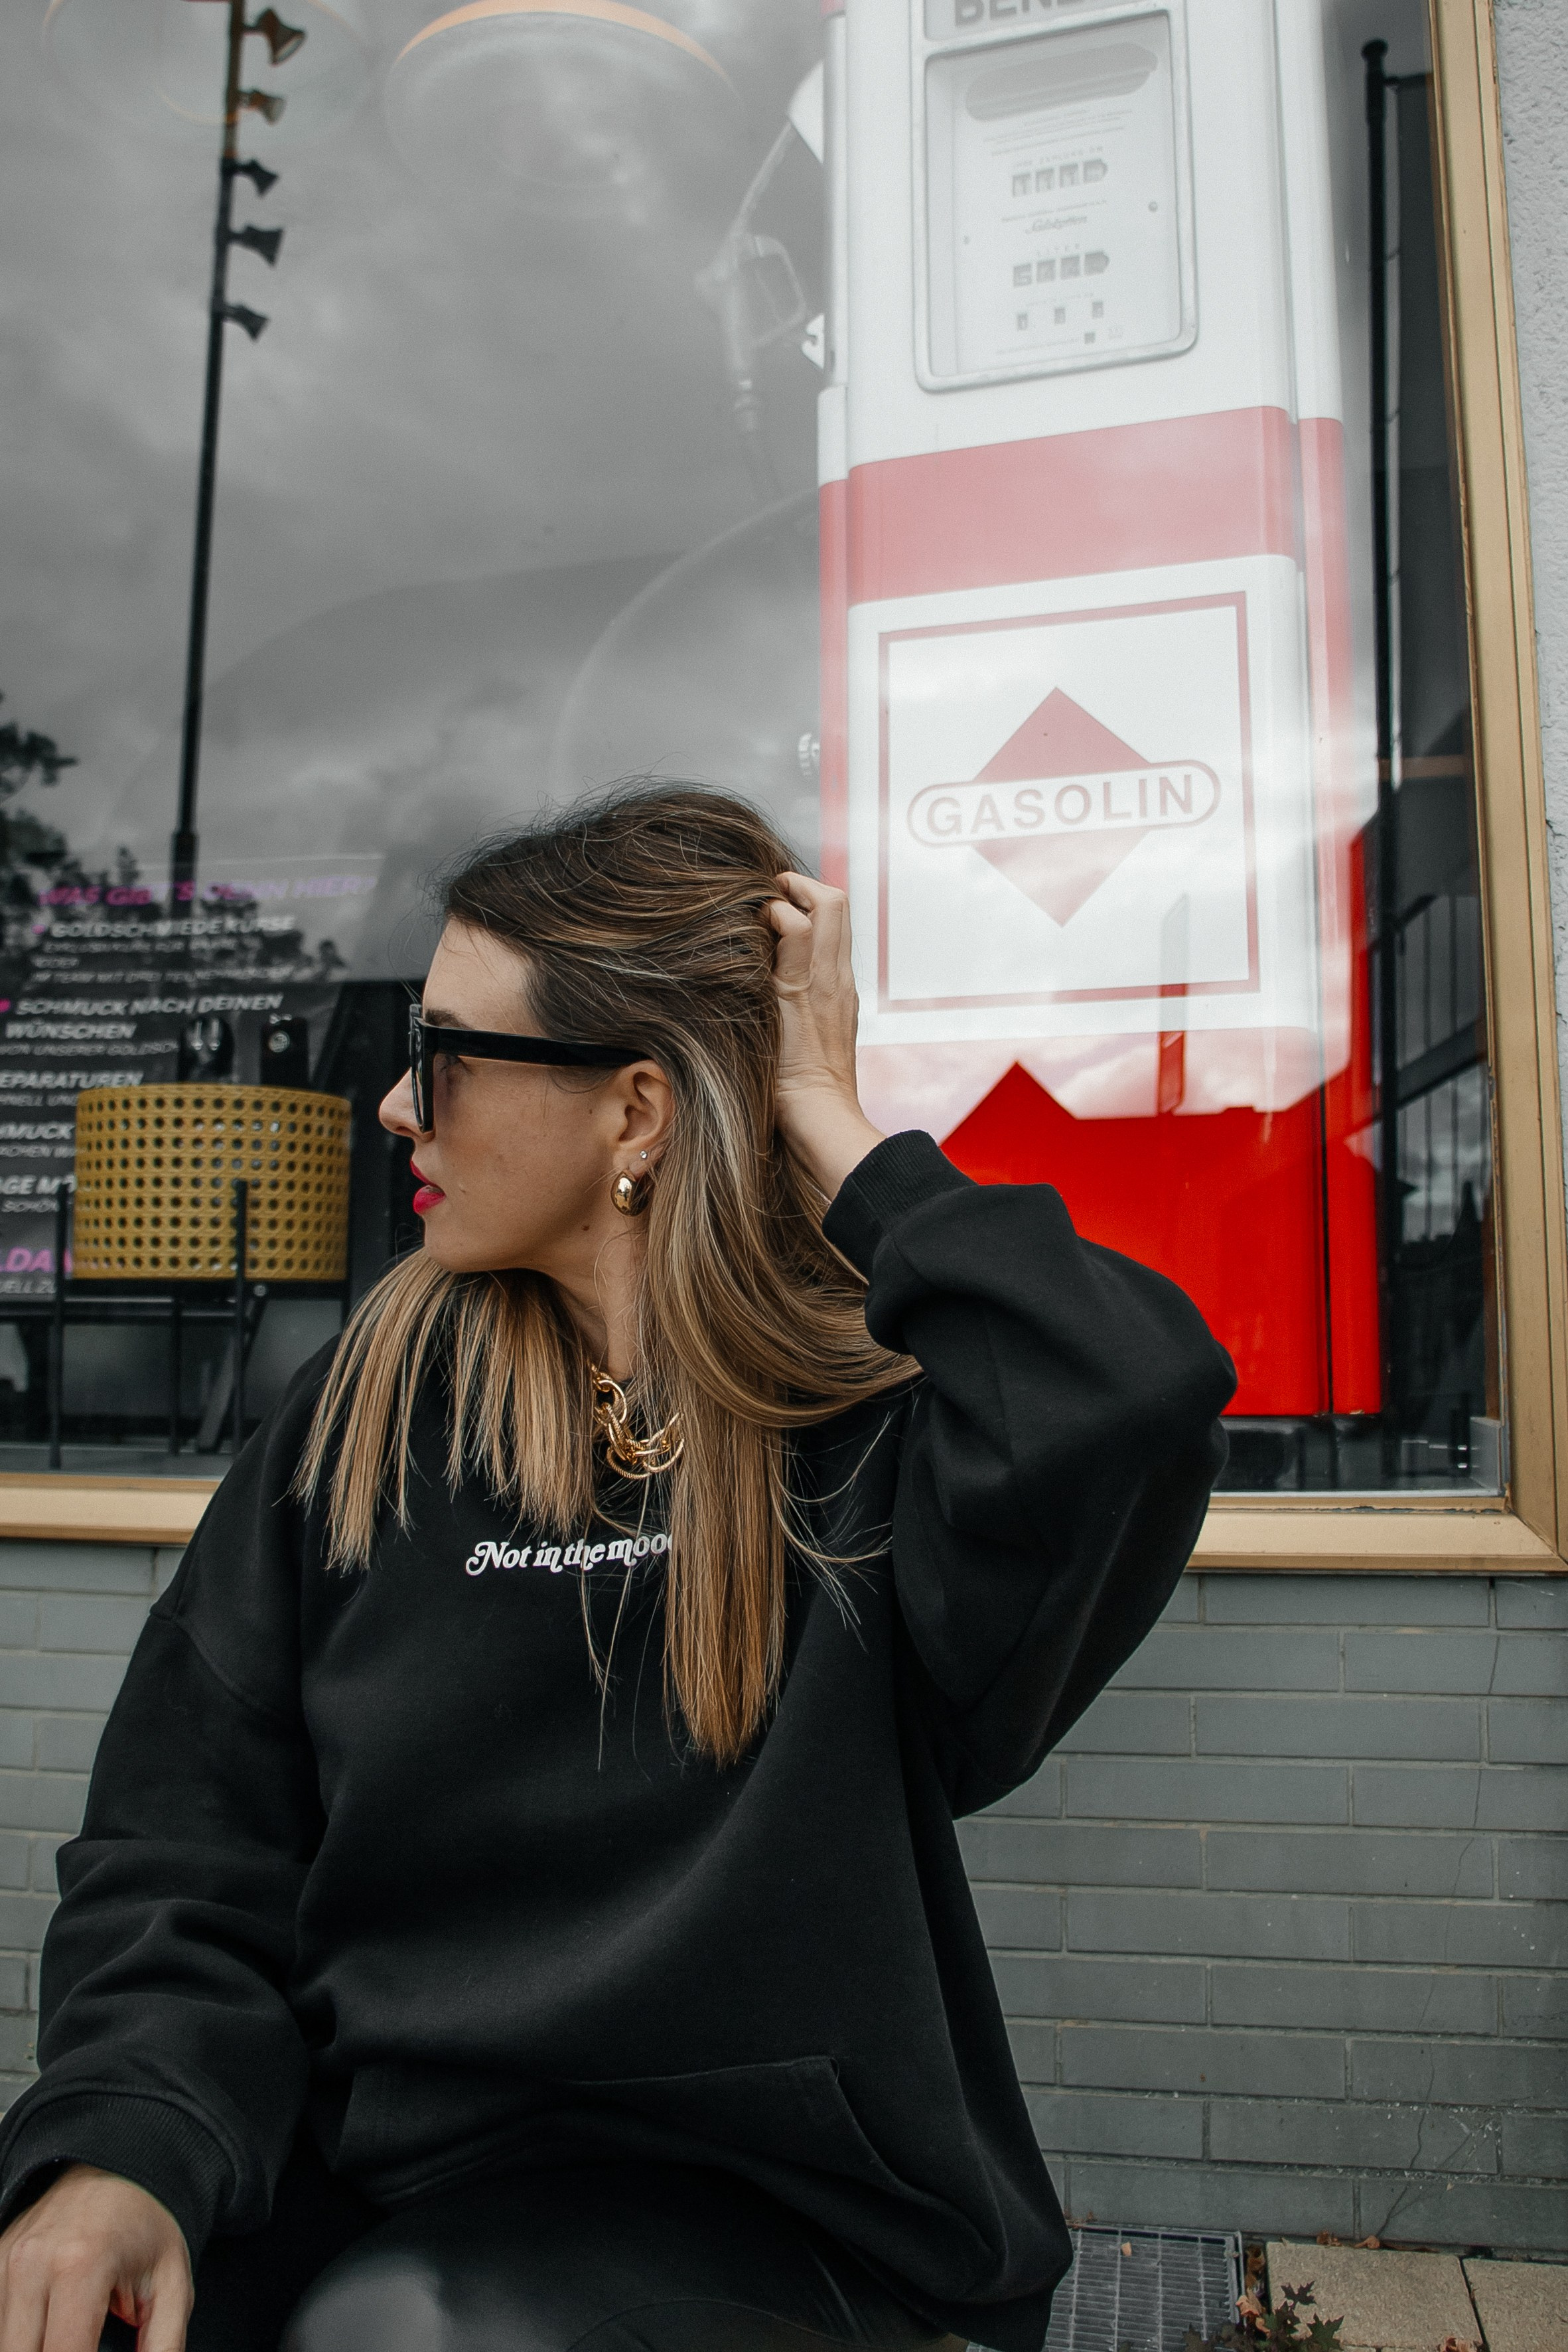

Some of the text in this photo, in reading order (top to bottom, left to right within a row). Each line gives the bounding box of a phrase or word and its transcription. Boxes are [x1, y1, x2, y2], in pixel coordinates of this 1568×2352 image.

[954, 0, 1086, 27] BE
[926, 774, 1193, 837] GASOLIN
[16, 992, 283, 1016] SCHMUCK NACH DEINEN
[5, 1017, 137, 1040] WÜNSCHEN
[465, 1541, 532, 1576] Not
[533, 1540, 563, 1573] in
[563, 1538, 606, 1571] the
